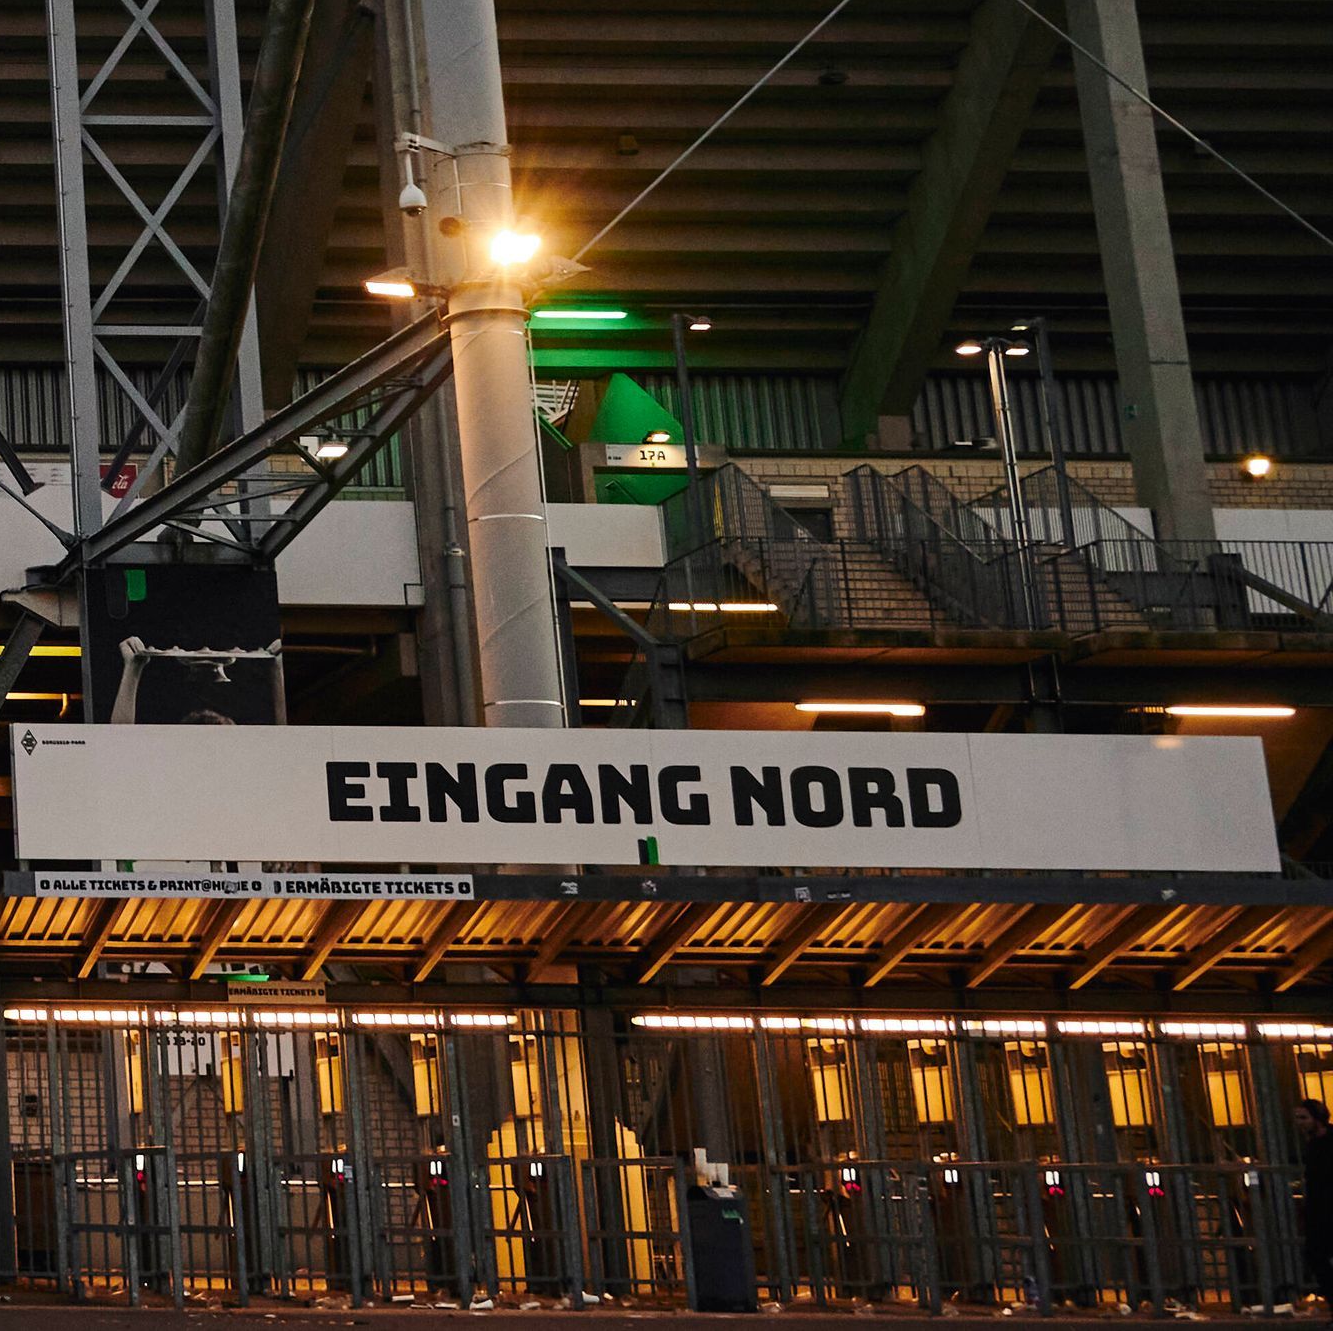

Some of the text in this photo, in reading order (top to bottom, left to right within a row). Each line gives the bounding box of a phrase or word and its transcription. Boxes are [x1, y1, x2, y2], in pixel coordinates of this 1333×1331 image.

[639, 450, 666, 461] 17A
[326, 761, 962, 829] EINGANG NORD
[53, 880, 87, 890] ALLE
[89, 880, 146, 891] TICKETS
[384, 881, 455, 895] TICKETS
[281, 988, 316, 997] TICKETS
